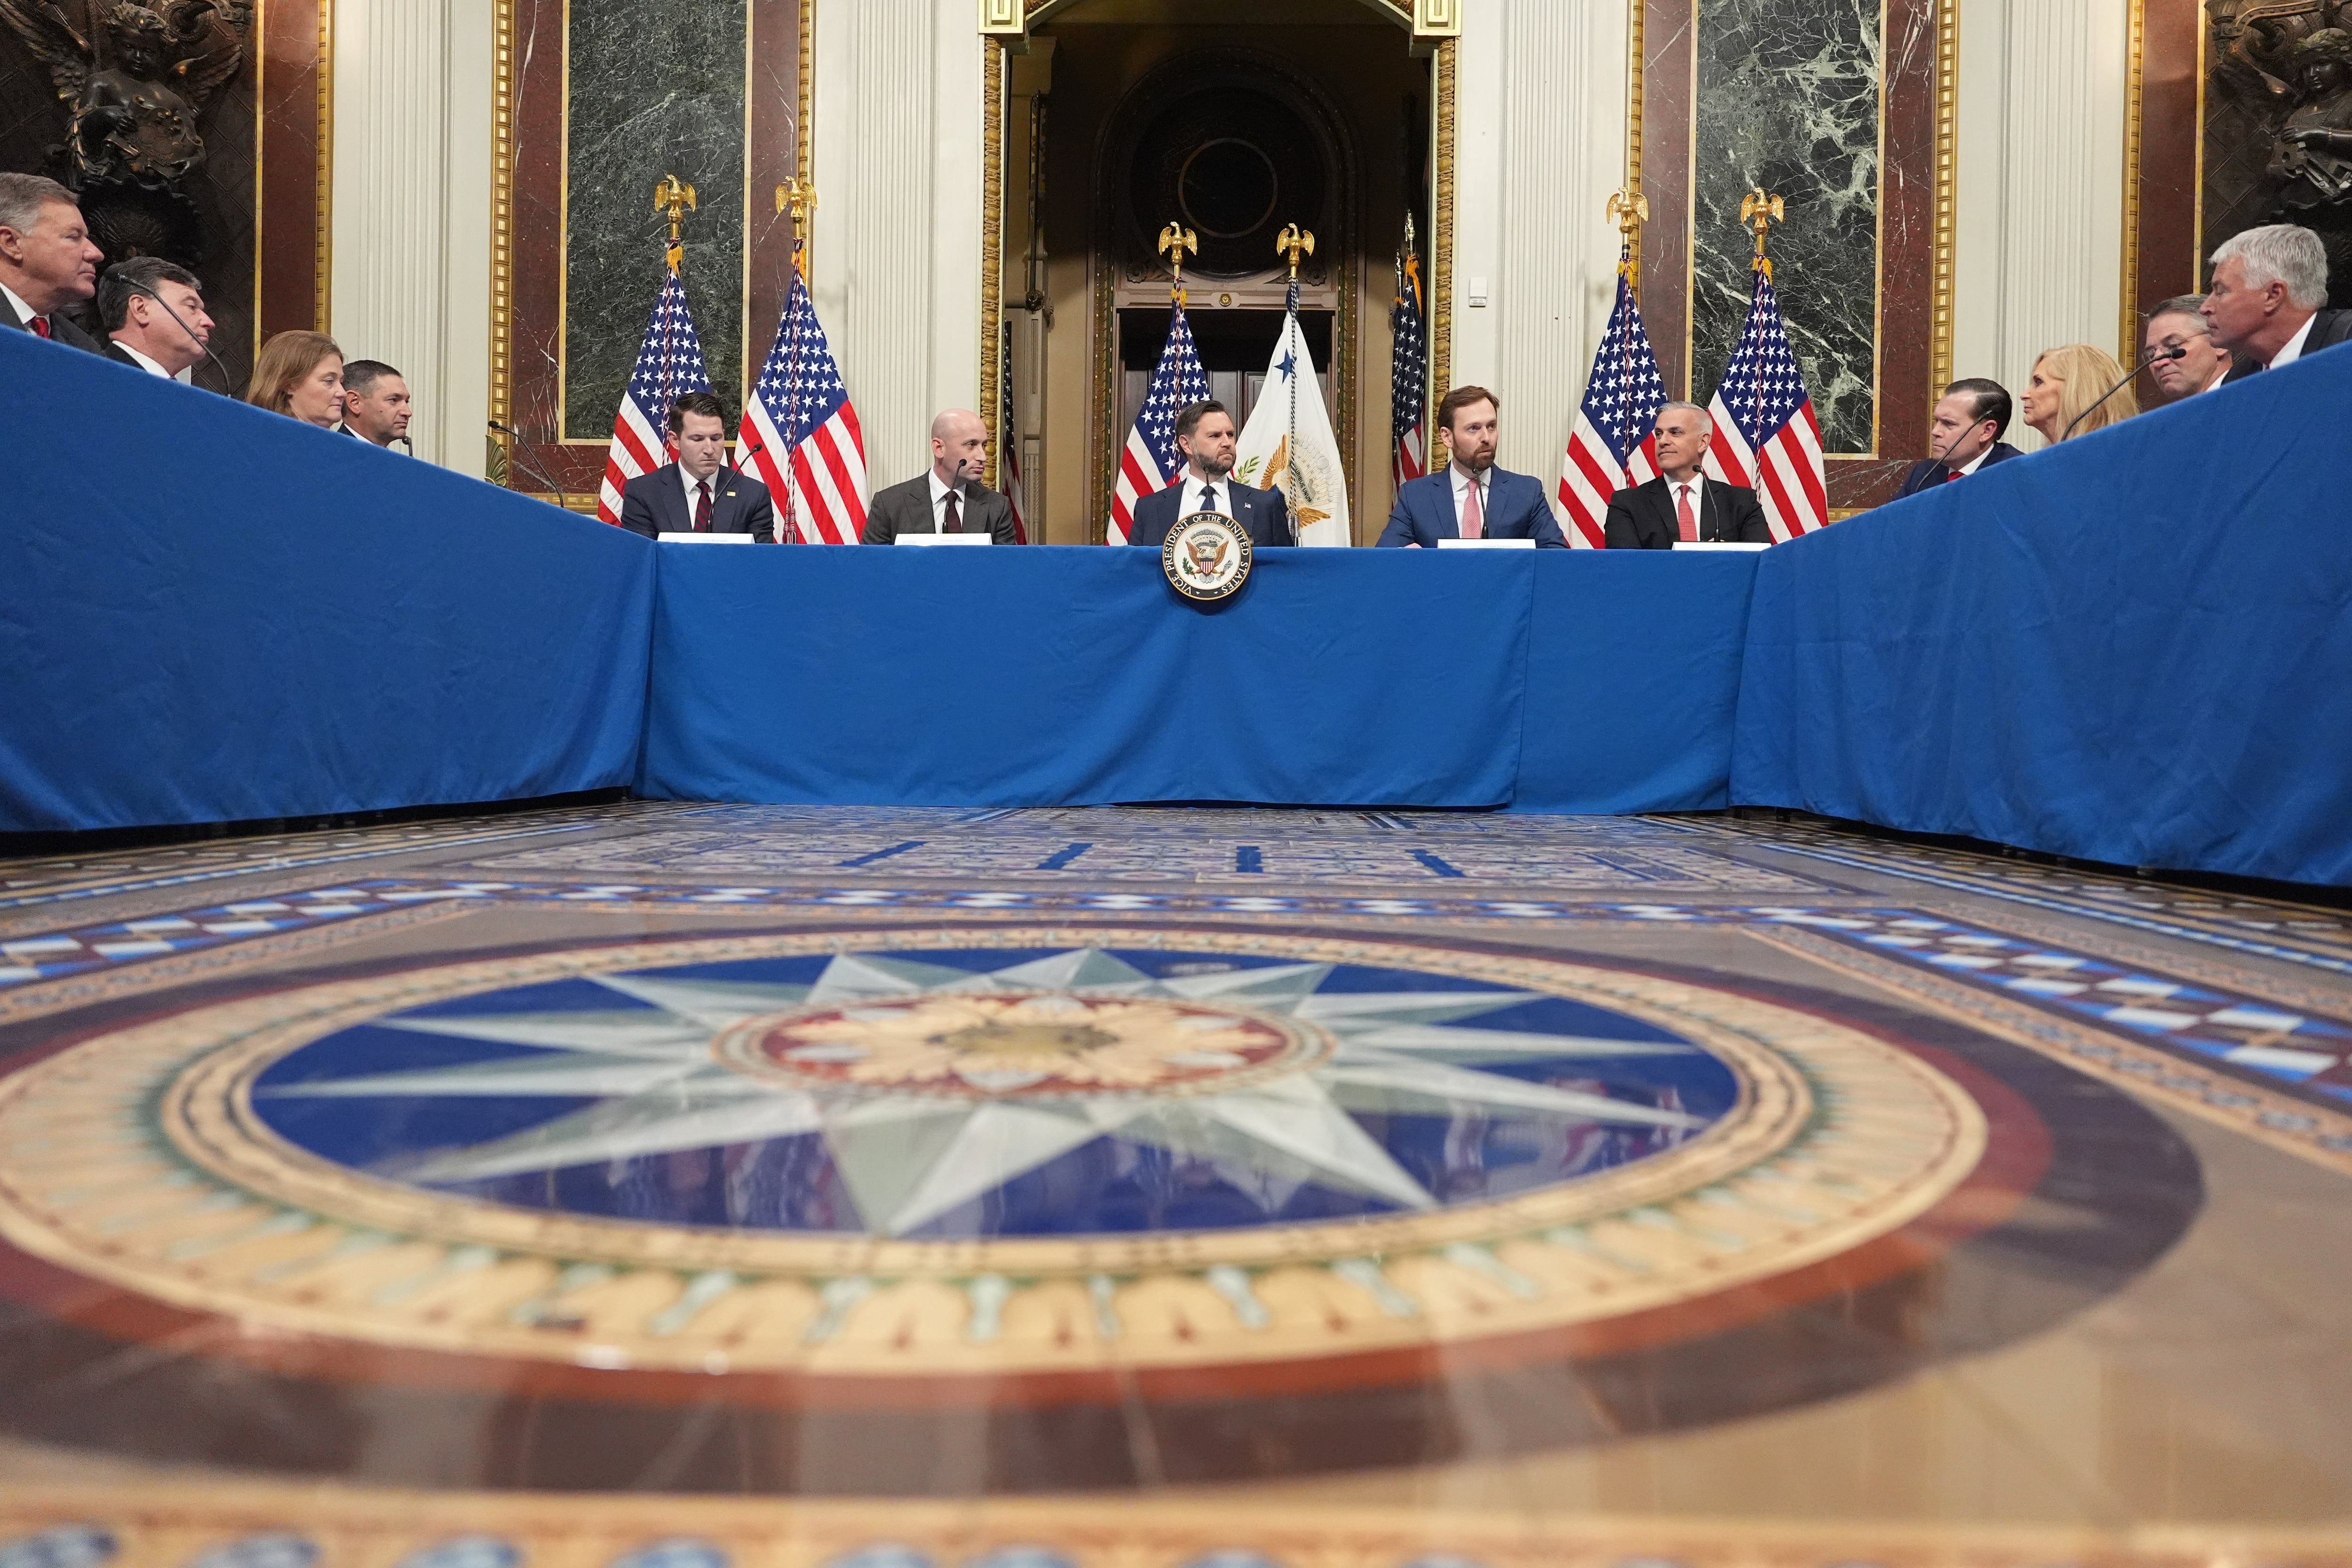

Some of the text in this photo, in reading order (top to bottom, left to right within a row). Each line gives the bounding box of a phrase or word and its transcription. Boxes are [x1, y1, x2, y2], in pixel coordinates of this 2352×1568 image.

[1295, 468, 1312, 503] URIBUS UNUM
[1165, 519, 1188, 570] PRESIDENT
[1225, 520, 1249, 555] UNITED
[1172, 574, 1192, 594] VICE
[1222, 562, 1248, 594] STATES
